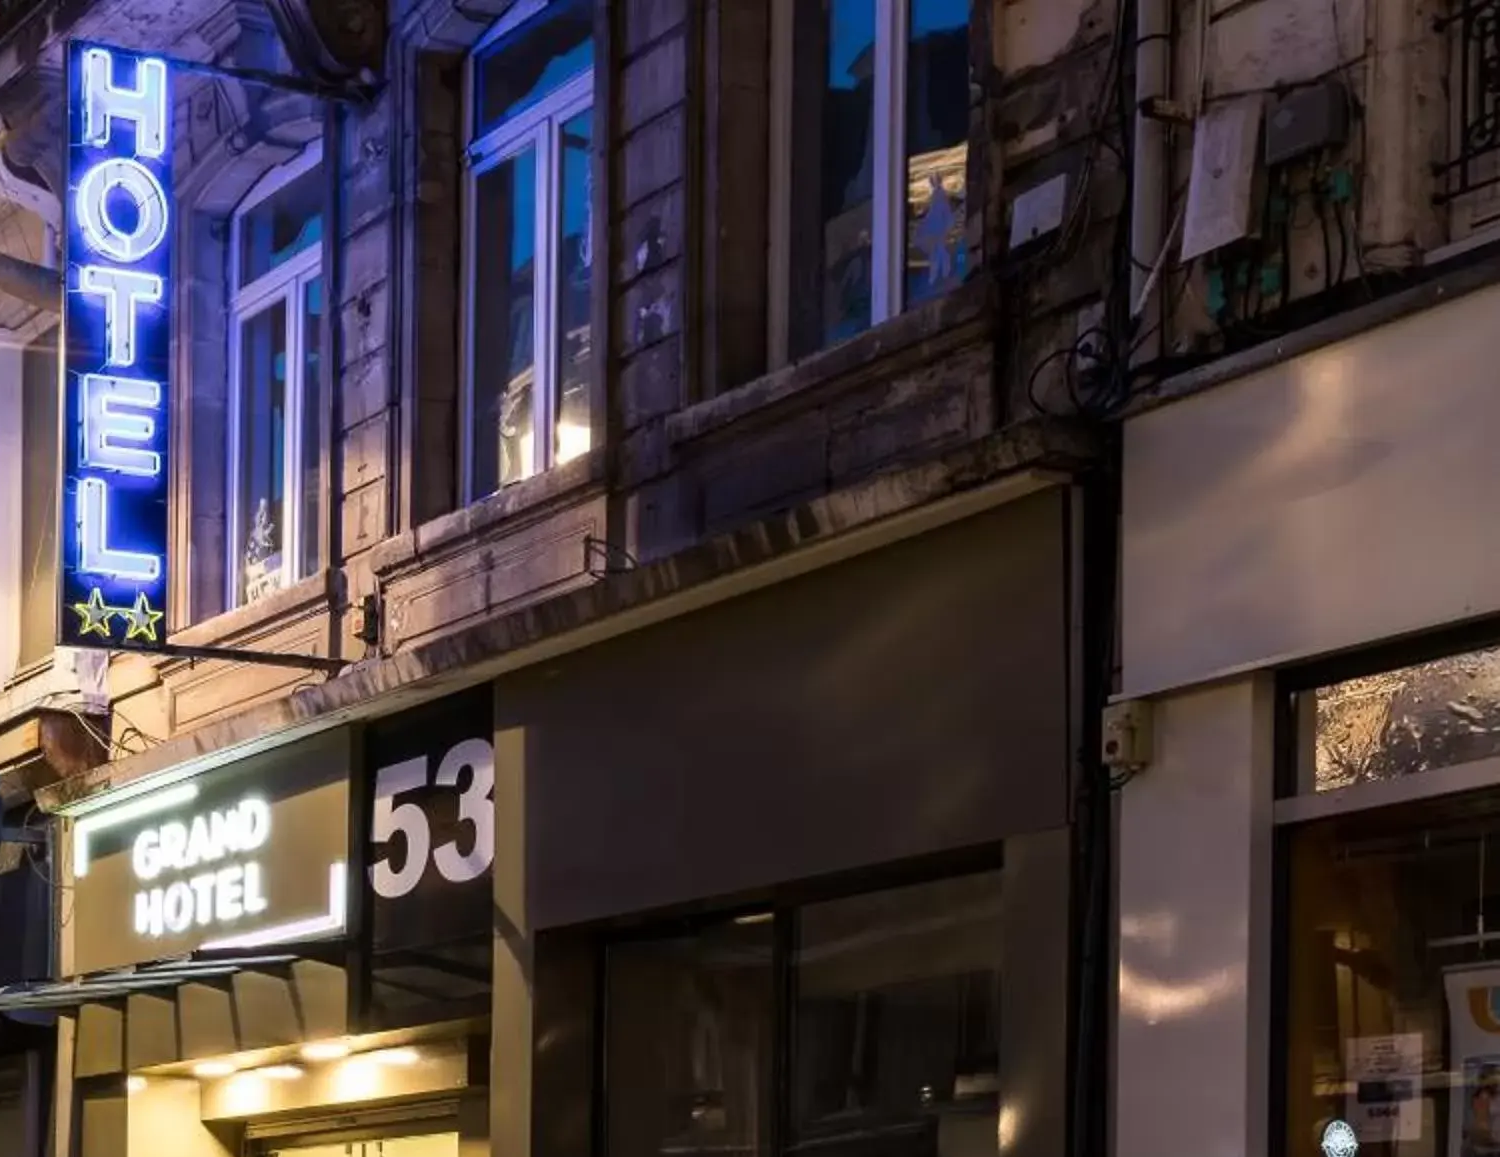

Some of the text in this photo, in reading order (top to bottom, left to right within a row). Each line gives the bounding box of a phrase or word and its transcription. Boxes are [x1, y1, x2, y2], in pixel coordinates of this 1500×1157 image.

[76, 47, 168, 579] HOTEL
[132, 798, 271, 880] GRAND
[368, 738, 495, 898] 53
[134, 862, 267, 937] HOTEL
